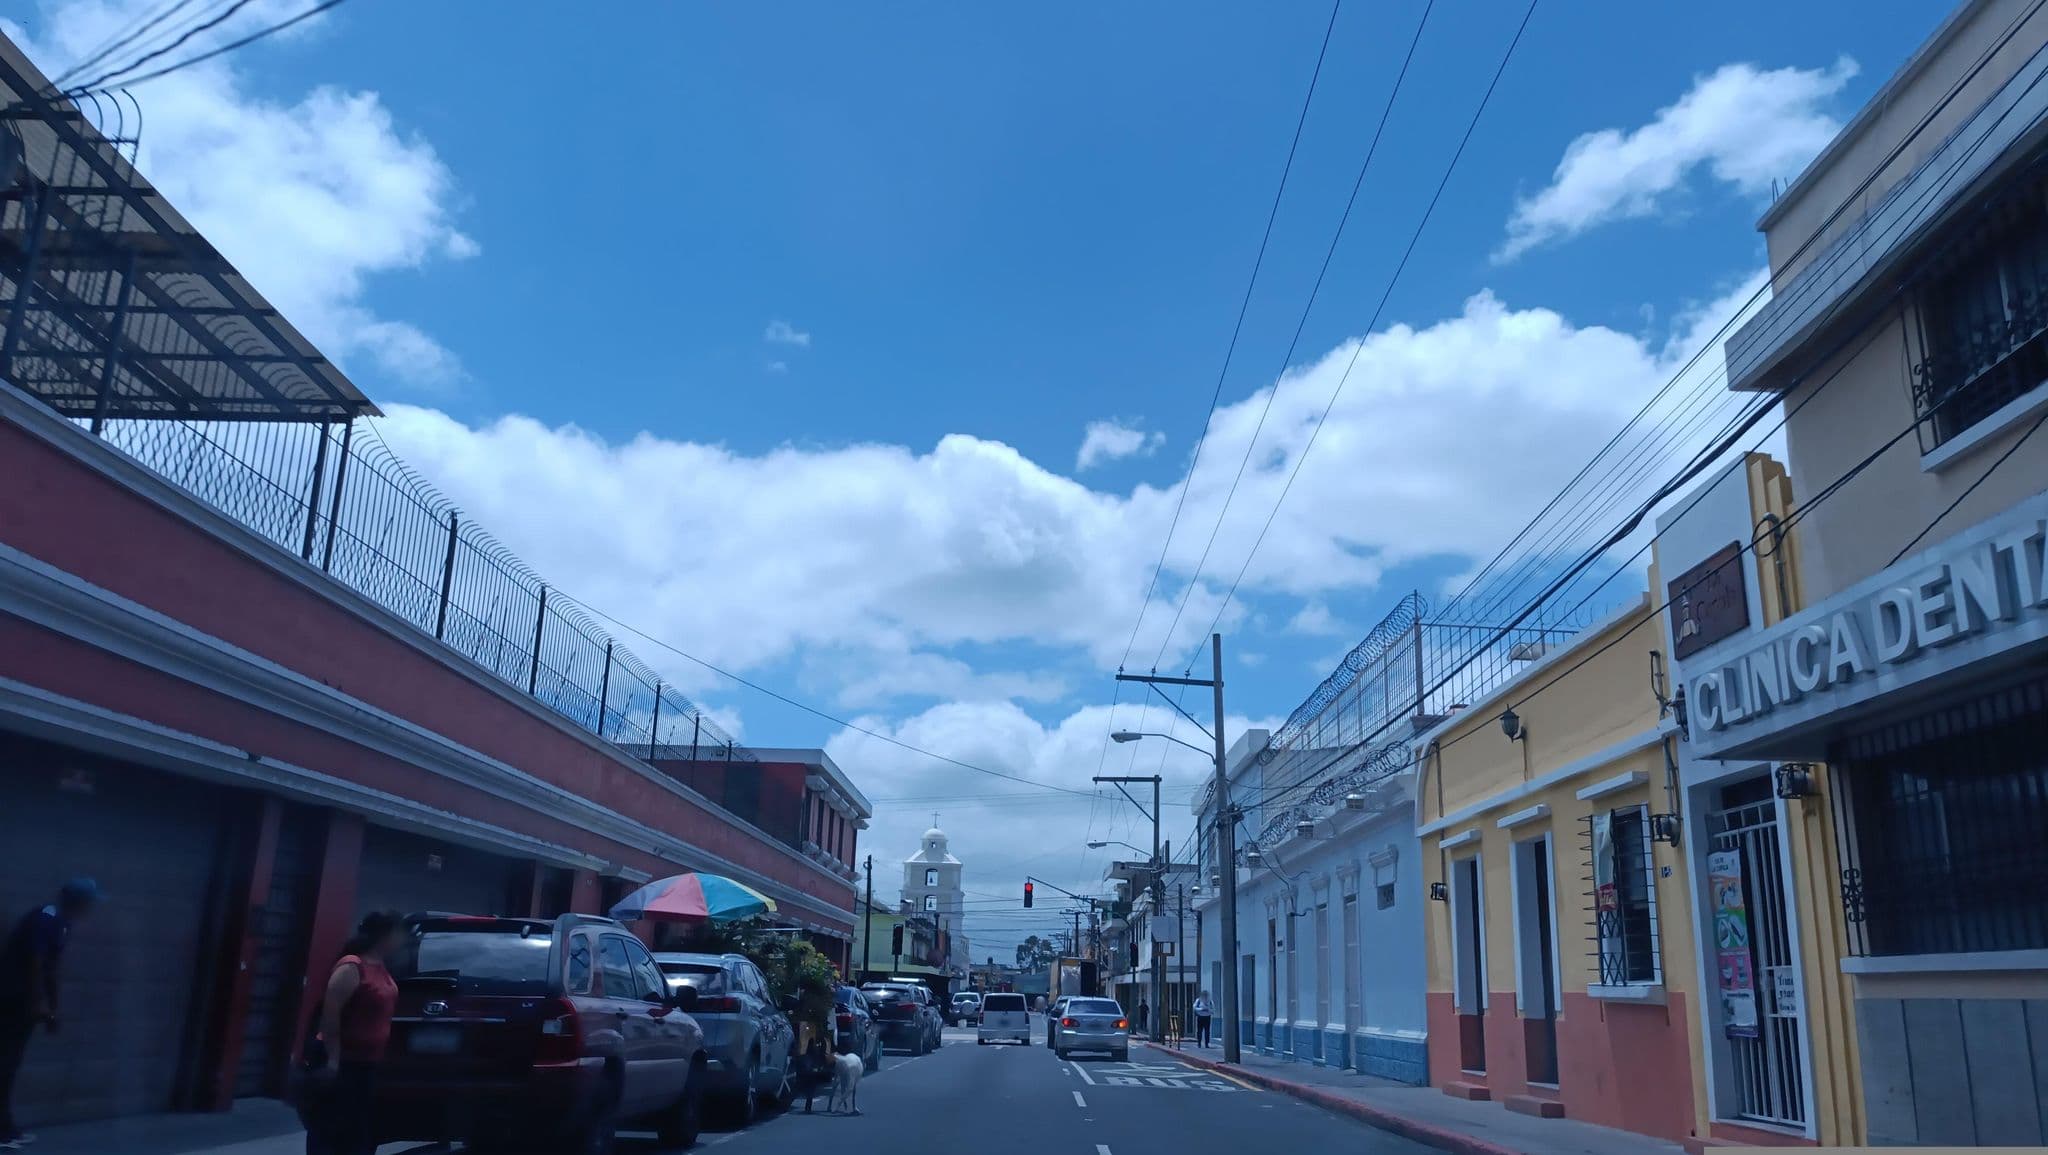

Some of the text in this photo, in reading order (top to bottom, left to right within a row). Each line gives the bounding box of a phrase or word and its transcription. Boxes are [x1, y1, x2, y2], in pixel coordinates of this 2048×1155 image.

[1693, 520, 2048, 732] CLINICA DENT
[1104, 1076, 1237, 1092] BUS
